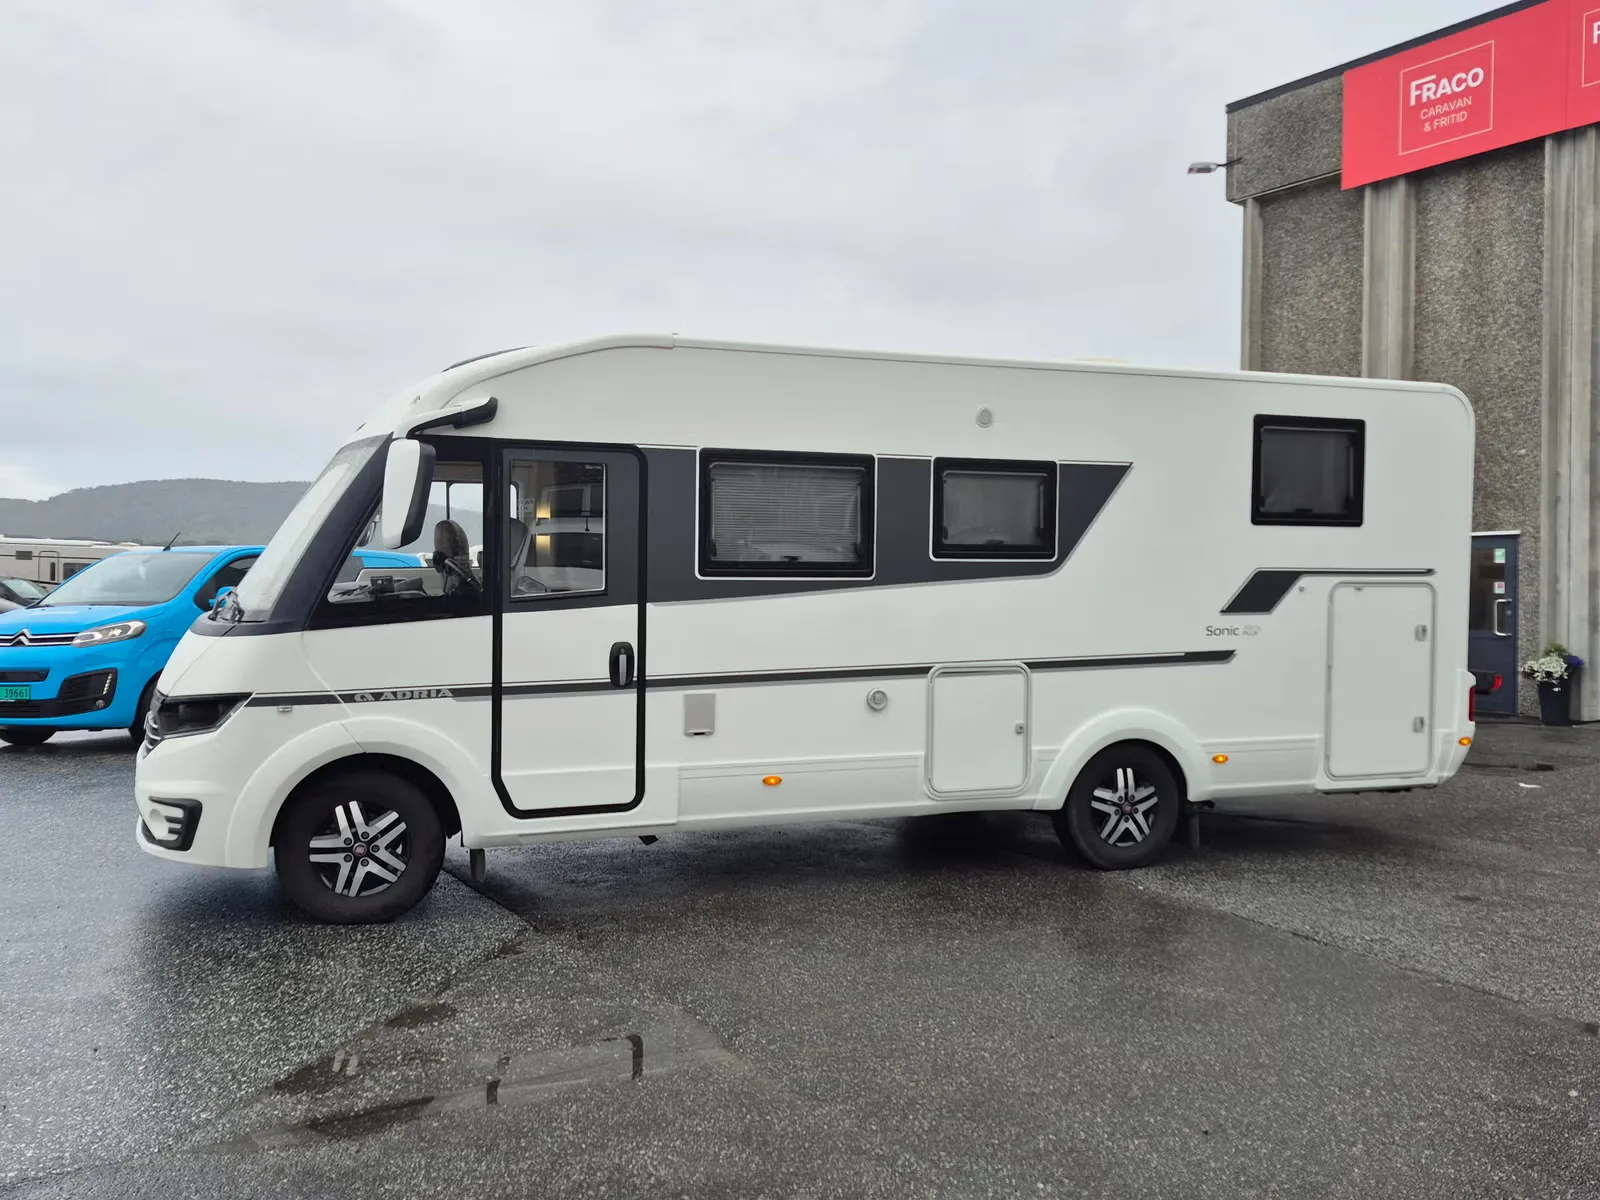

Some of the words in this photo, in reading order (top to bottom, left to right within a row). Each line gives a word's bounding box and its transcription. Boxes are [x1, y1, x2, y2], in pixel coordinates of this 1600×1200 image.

[1409, 67, 1485, 107] FRACO
[1420, 96, 1472, 120] CARAVAN
[1423, 121, 1432, 132] &
[1433, 111, 1468, 129] FRITID
[1205, 625, 1240, 636] Sonic
[4, 688, 29, 698] 39661
[380, 688, 454, 701] ADRIA
